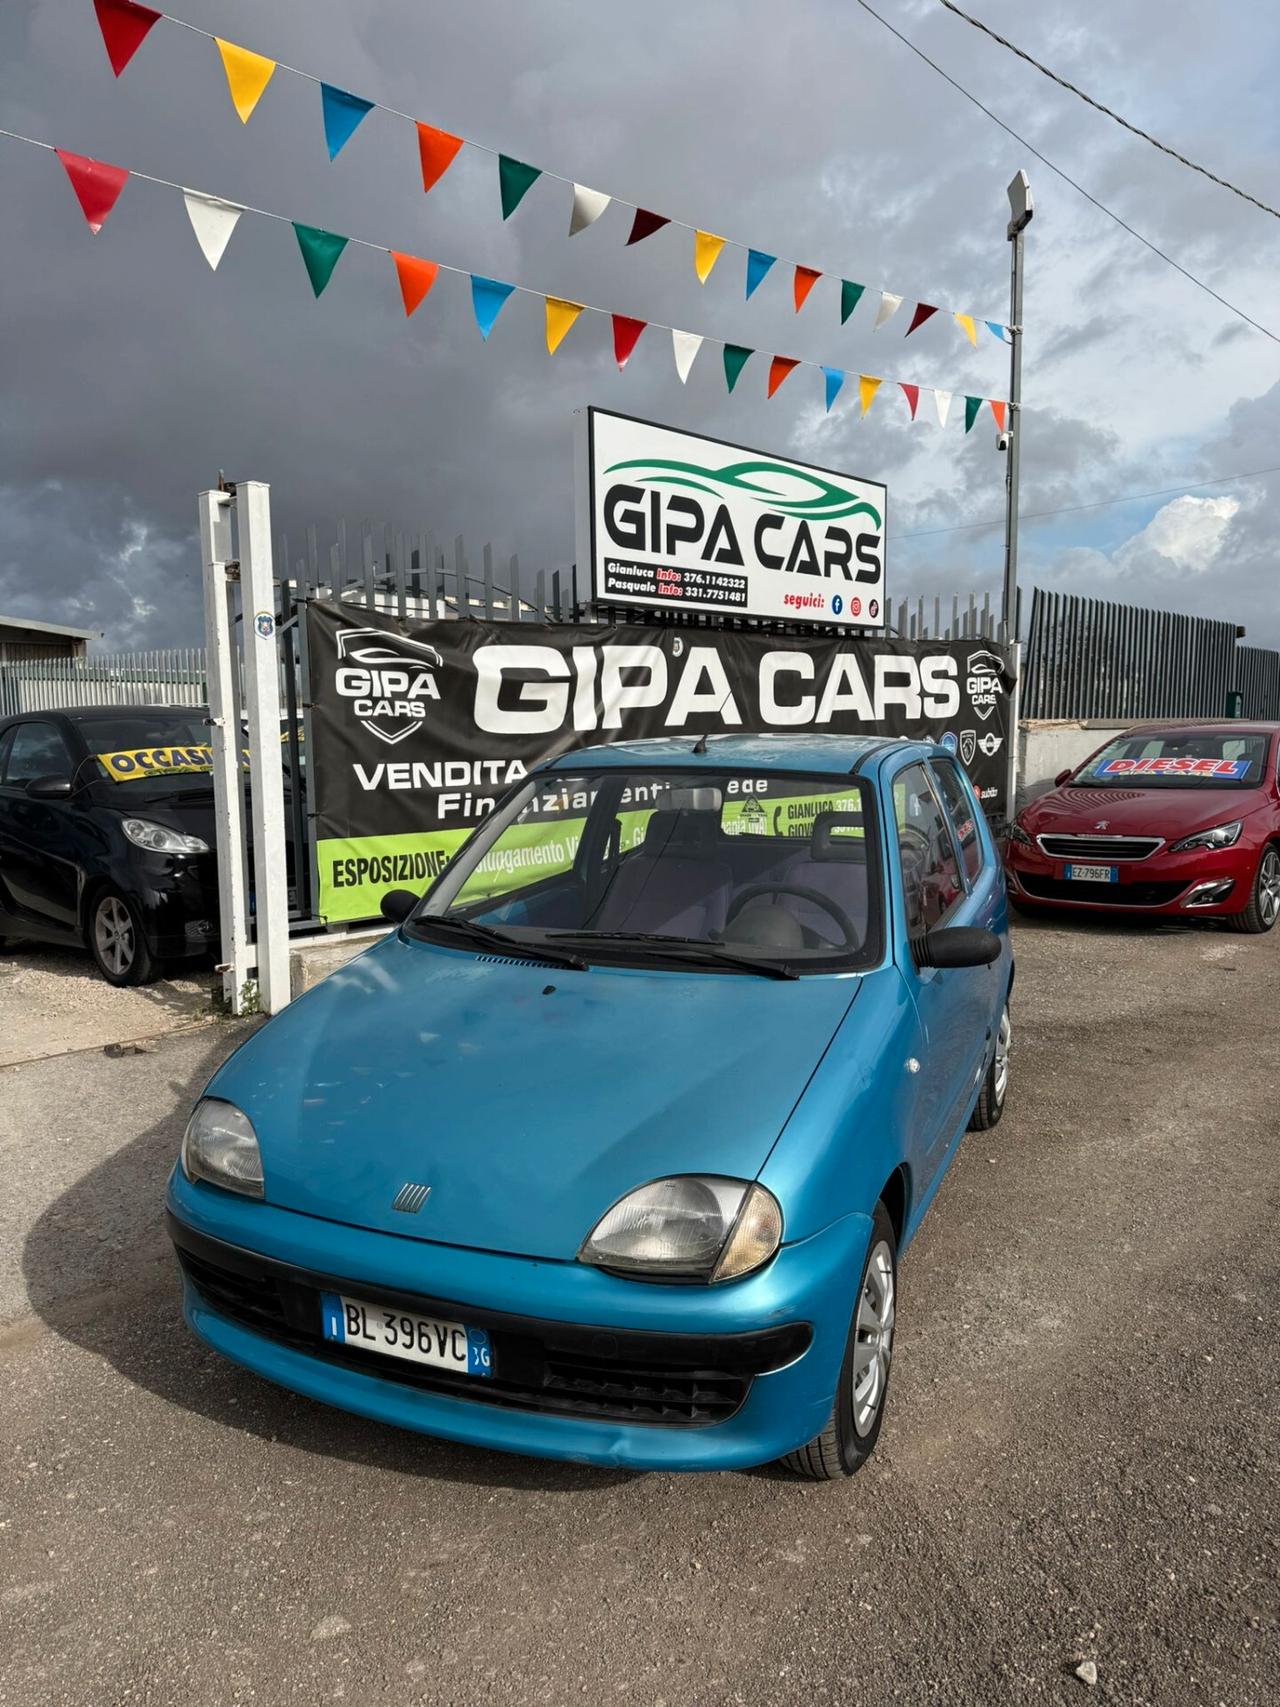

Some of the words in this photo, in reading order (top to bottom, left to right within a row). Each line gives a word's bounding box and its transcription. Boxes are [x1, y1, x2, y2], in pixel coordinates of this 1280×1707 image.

[603, 483, 745, 567] GIPA
[754, 513, 881, 585] CARS
[607, 562, 654, 578] Gianluca
[656, 567, 682, 583] Info:
[683, 572, 745, 589] 376.1142322
[607, 577, 656, 594] Pasquale
[657, 582, 683, 597] Info:
[685, 586, 746, 602] 331.7751481
[783, 592, 825, 609] seguici:
[335, 667, 441, 699] GIPA
[472, 645, 743, 734] GIPA
[758, 650, 960, 726] CARS
[966, 677, 1003, 694] GIPA
[353, 699, 426, 718] CARS
[971, 694, 997, 705] CARS
[110, 749, 212, 773] OCCASI
[1103, 757, 1239, 774] DIESEL
[352, 759, 529, 791] VENDITA
[726, 778, 769, 794] ede
[345, 1303, 376, 1342] BL
[383, 1312, 466, 1362] 396VC
